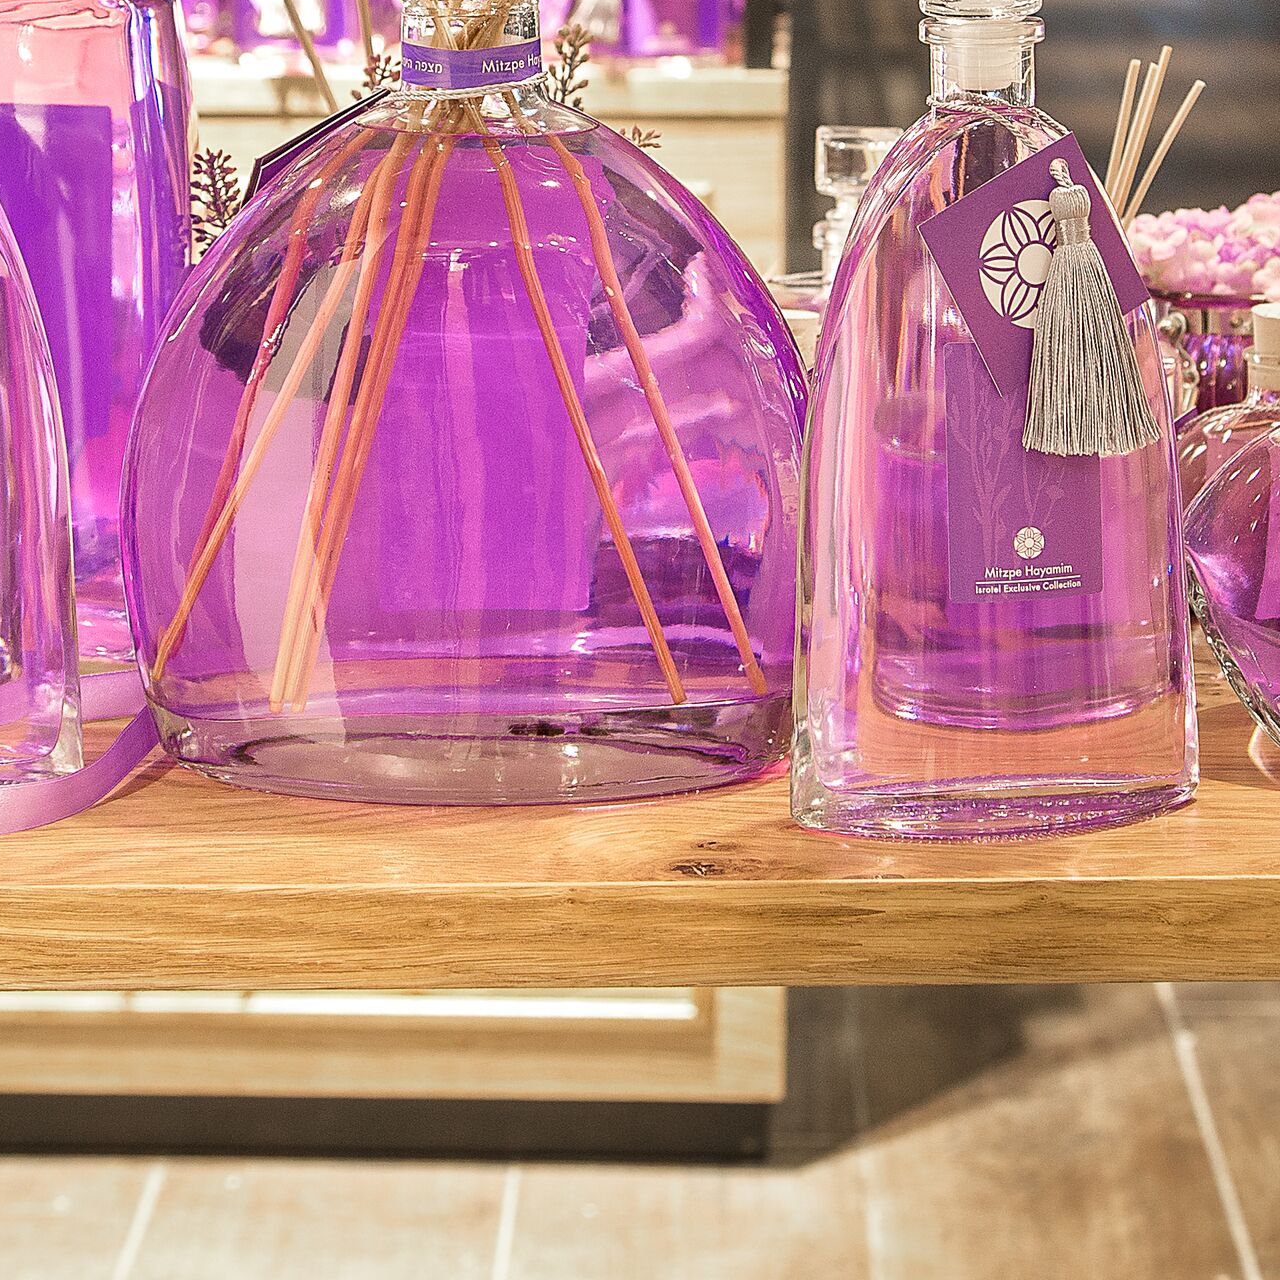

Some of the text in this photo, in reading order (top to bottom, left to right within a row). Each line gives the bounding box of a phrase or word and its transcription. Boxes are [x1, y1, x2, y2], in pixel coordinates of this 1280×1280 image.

[414, 60, 443, 74] מצפה
[482, 59, 525, 73] Mitzpe
[984, 563, 1073, 580] Mitzpe Hayamim
[975, 580, 1081, 594] Isrotel Exclusive Collection
